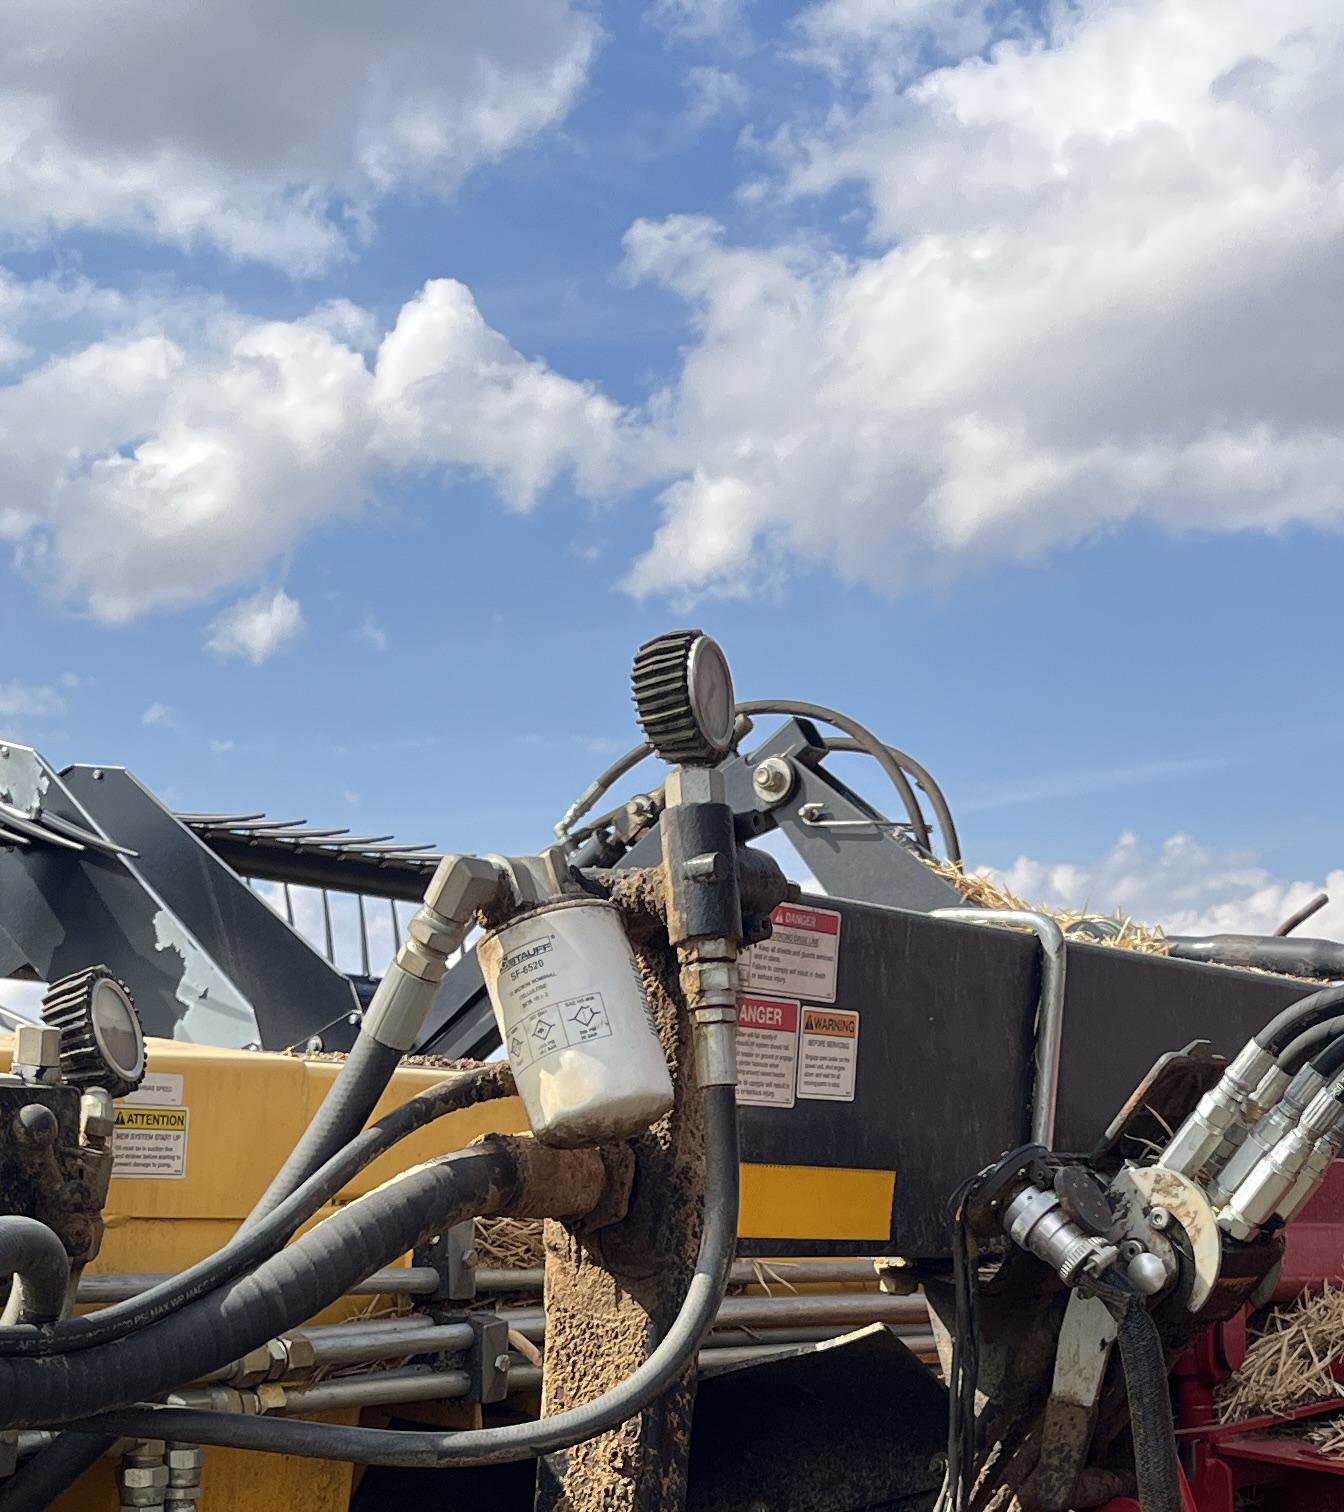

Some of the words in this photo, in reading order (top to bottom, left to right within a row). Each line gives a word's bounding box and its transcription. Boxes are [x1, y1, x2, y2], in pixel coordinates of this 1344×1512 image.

[785, 912, 816, 927] DANGER
[511, 959, 544, 981] SF-6520
[740, 1005, 782, 1025] ANGER
[814, 1017, 854, 1033] WARNING
[127, 1113, 184, 1126] ATTENTION
[150, 1301, 169, 1317] MAX
[170, 1294, 185, 1308] WP
